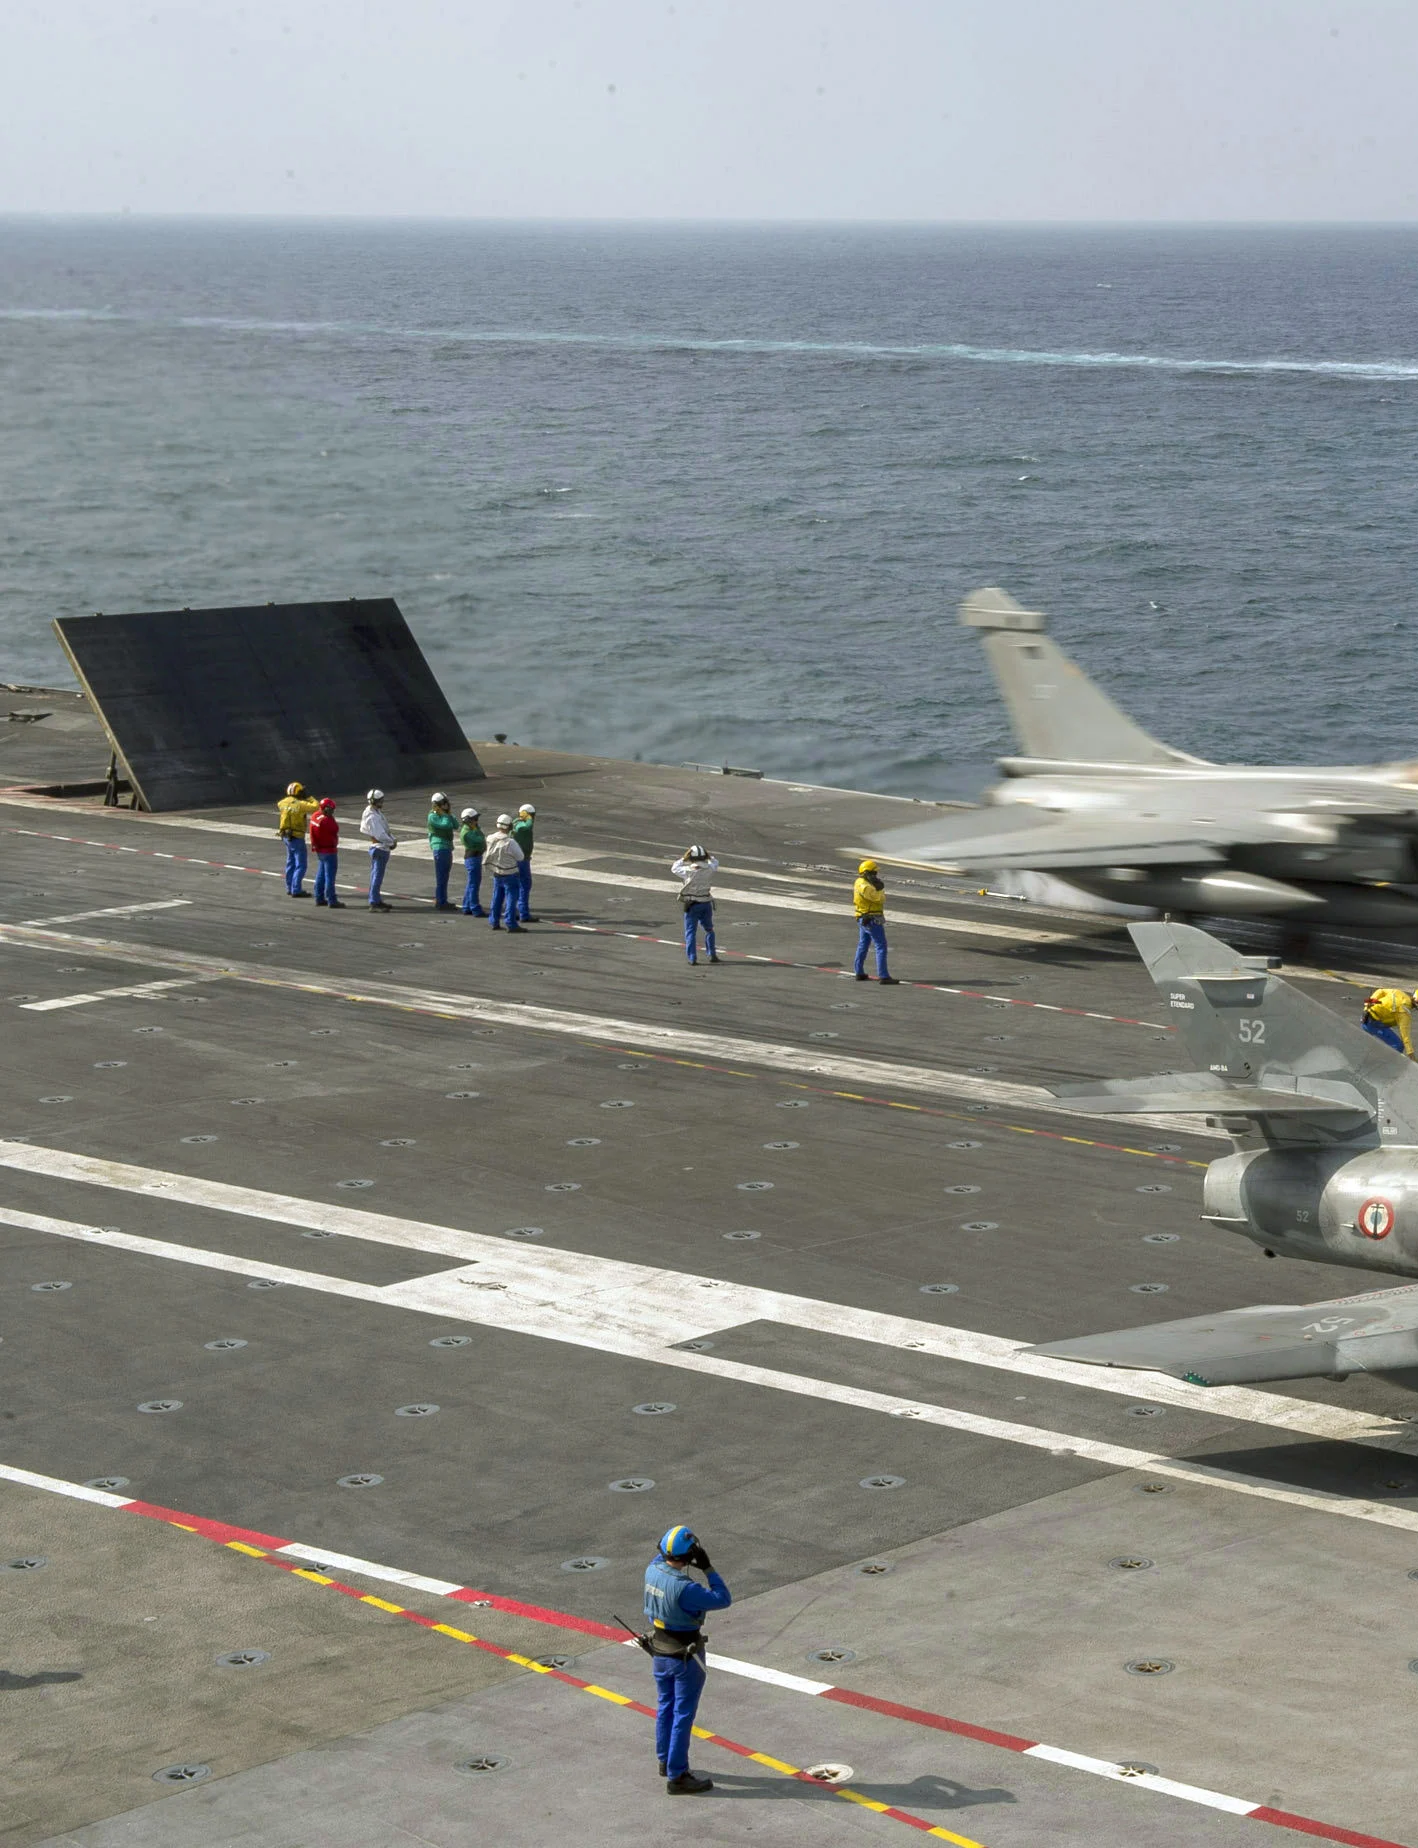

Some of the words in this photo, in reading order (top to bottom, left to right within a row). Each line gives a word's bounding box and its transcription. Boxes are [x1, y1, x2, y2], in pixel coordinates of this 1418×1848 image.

[1239, 1018, 1265, 1044] 52
[1296, 1210, 1309, 1223] 52
[1301, 1316, 1355, 1332] 52
